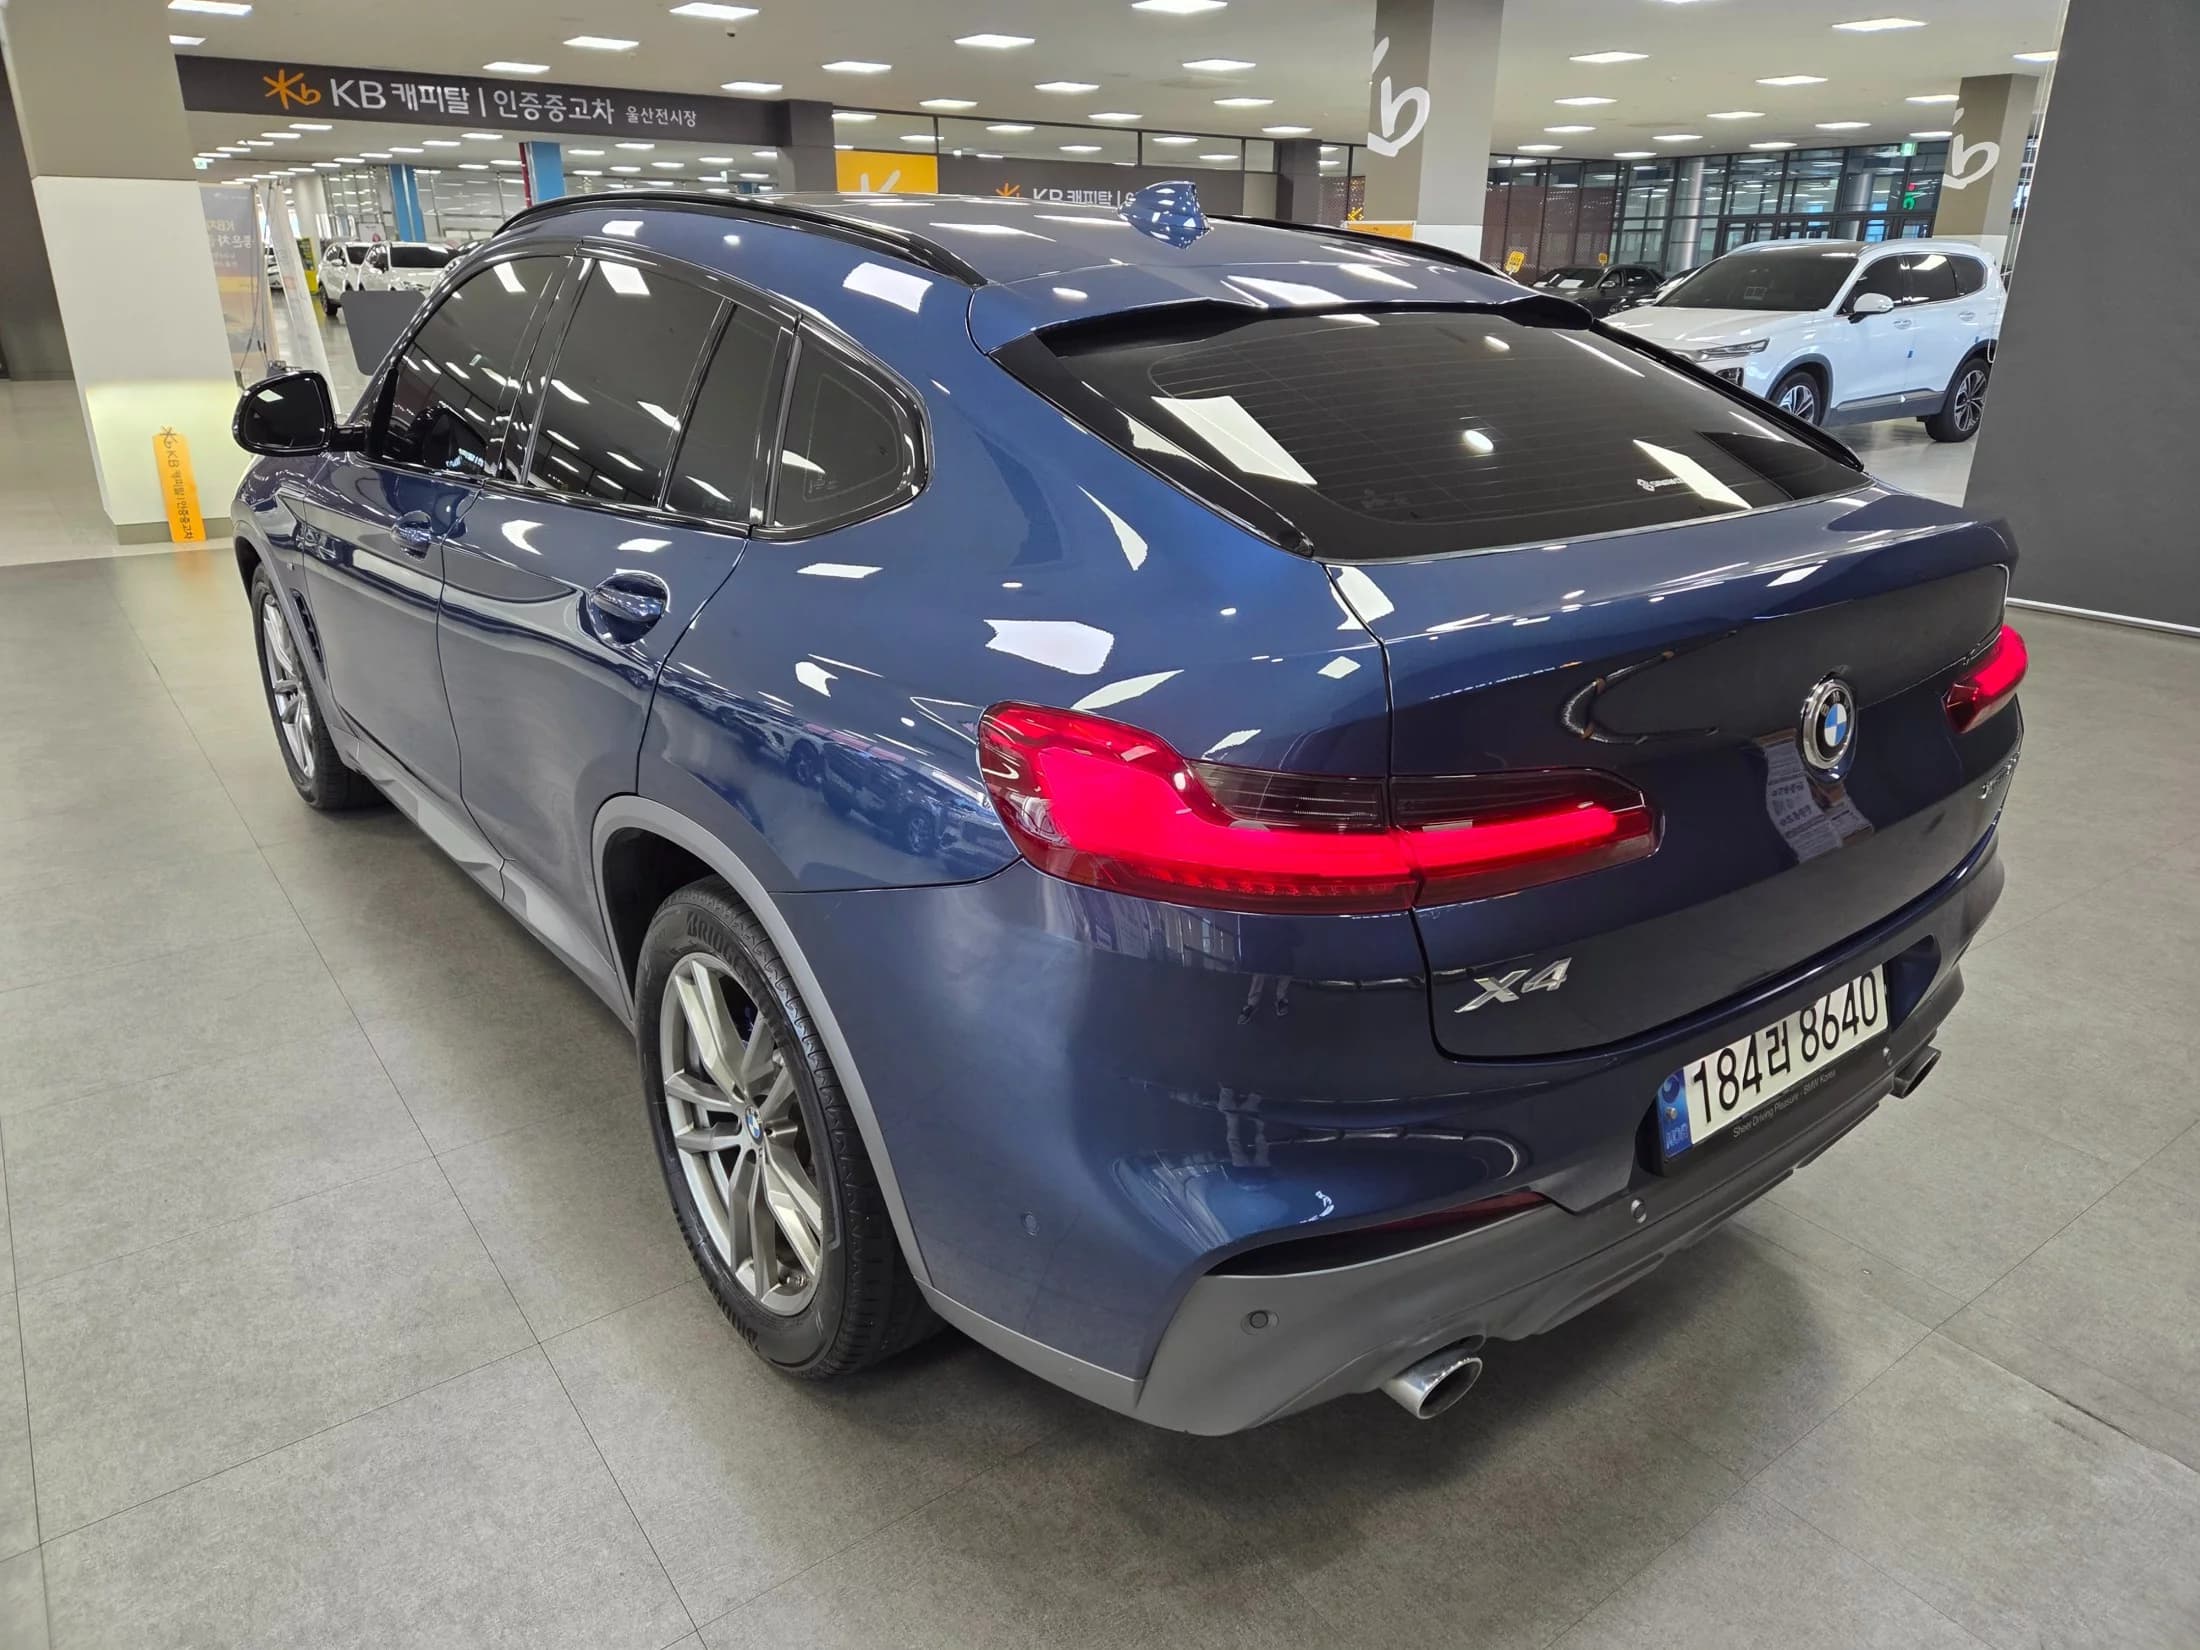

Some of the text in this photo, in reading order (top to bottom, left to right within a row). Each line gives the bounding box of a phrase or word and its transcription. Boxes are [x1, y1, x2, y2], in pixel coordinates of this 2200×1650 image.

[493, 89, 615, 125] 인증중고차
[625, 105, 697, 127] 울산전시장
[1454, 957, 1572, 1013] X4
[1693, 970, 1878, 1123] 184러 8640
[1752, 1107, 1774, 1127] Driving
